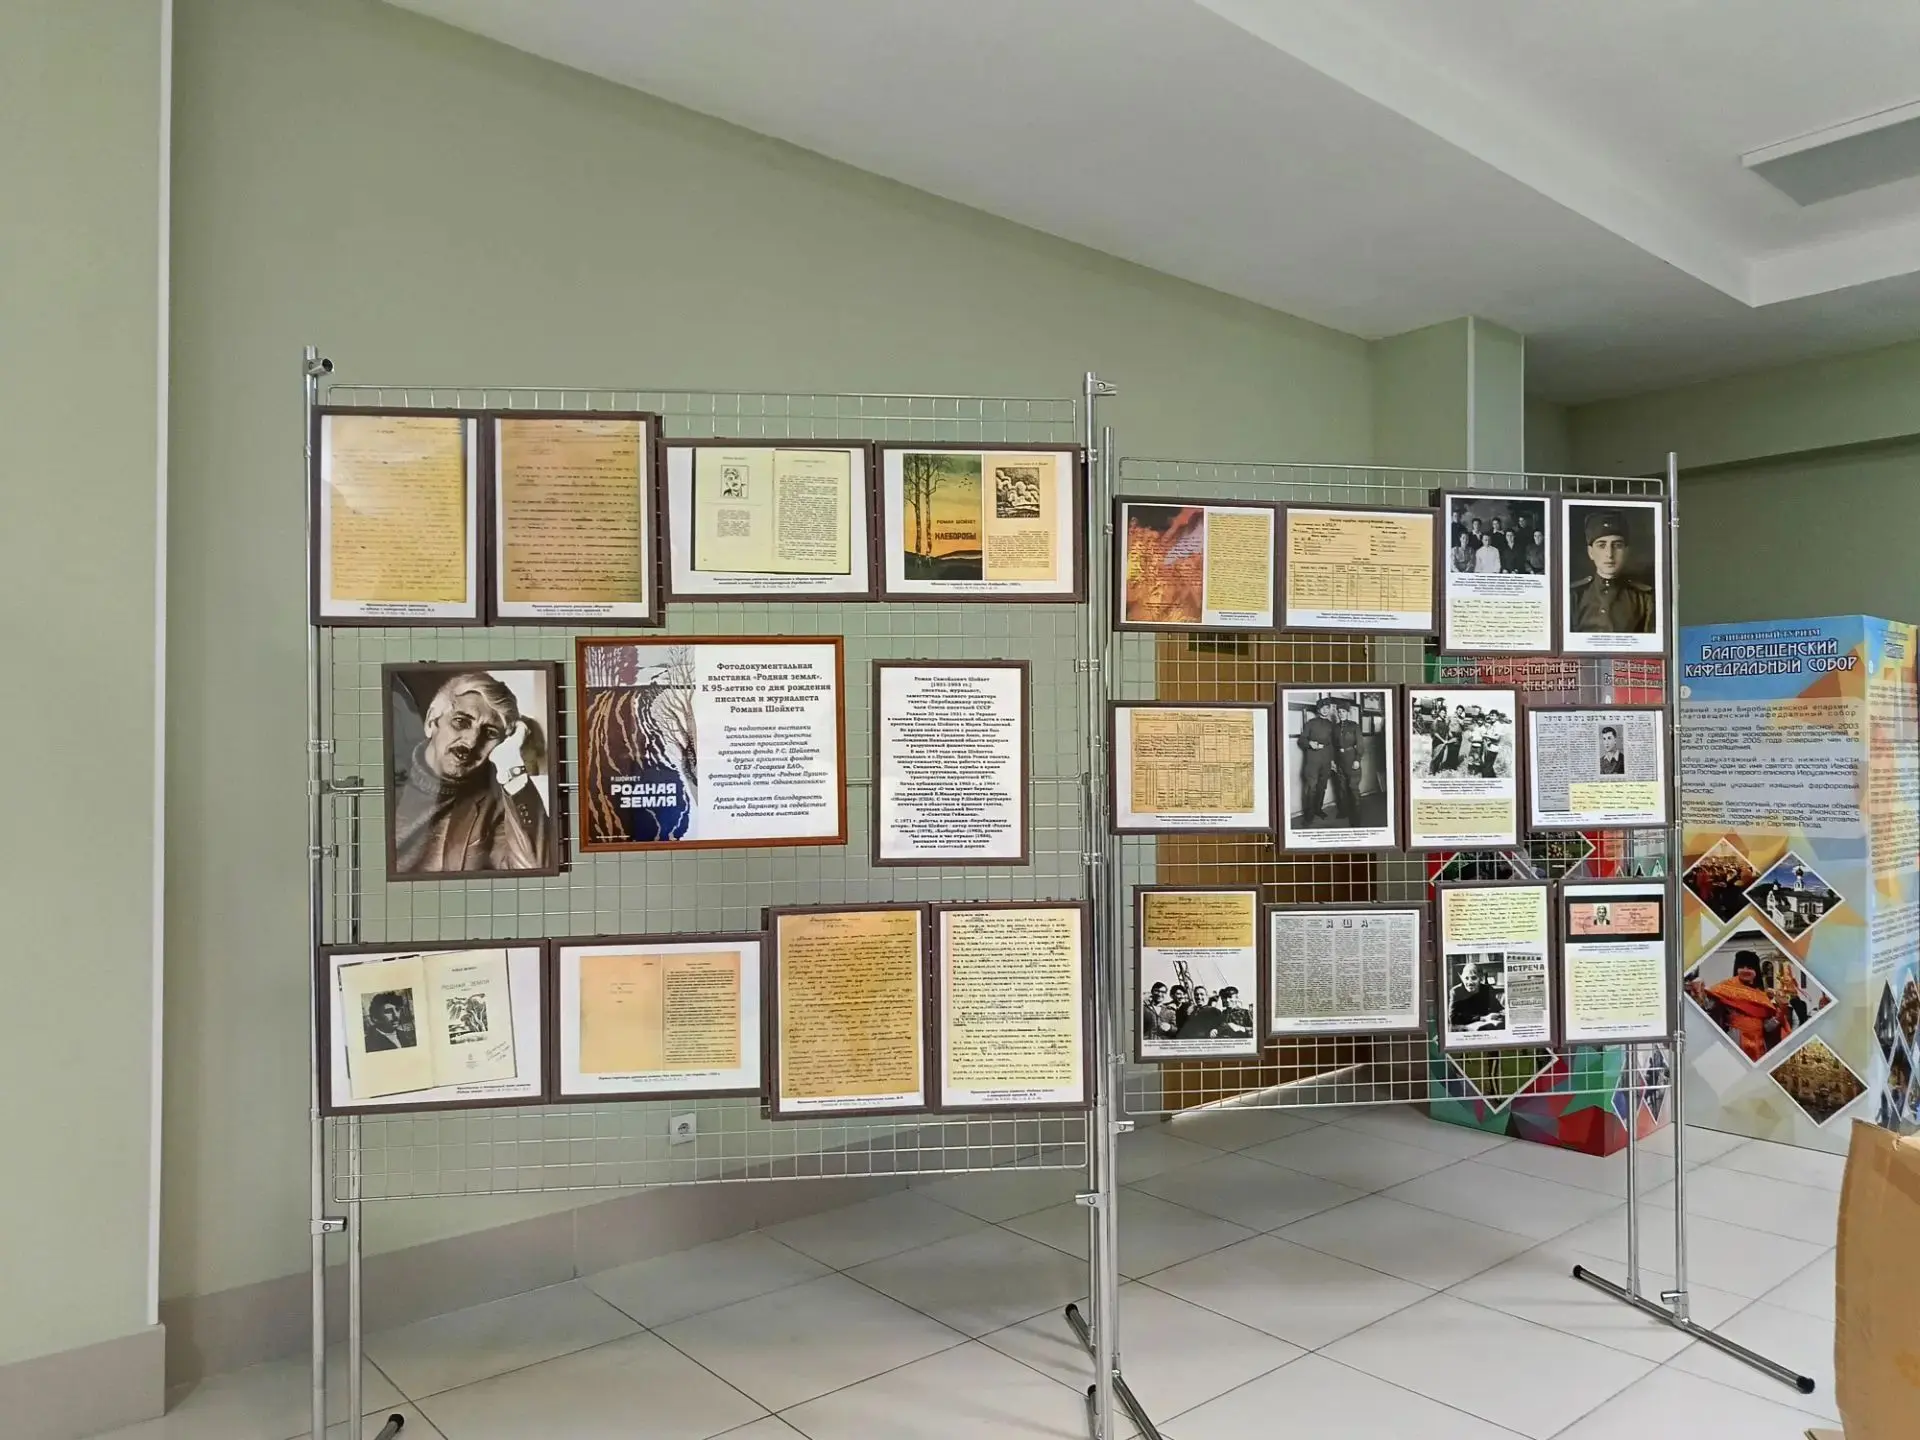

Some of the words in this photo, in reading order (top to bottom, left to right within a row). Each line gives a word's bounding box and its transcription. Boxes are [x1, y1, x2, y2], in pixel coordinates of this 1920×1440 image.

[935, 532, 976, 540] ХЛЕБОРОБЫ
[1702, 638, 1838, 661] БЛАГОВЕЩЕНСКИЙ
[717, 663, 812, 671] Фотодокументальная
[1685, 658, 1802, 677] КАФЕДРАЛЬНЫЙ
[1808, 656, 1858, 672] СОБОР
[788, 684, 831, 692] рождения
[610, 783, 676, 795] РОДНАЯ
[620, 796, 677, 808] ЗЕМЛЯ
[1507, 964, 1544, 972] ВСТРЕЧА
